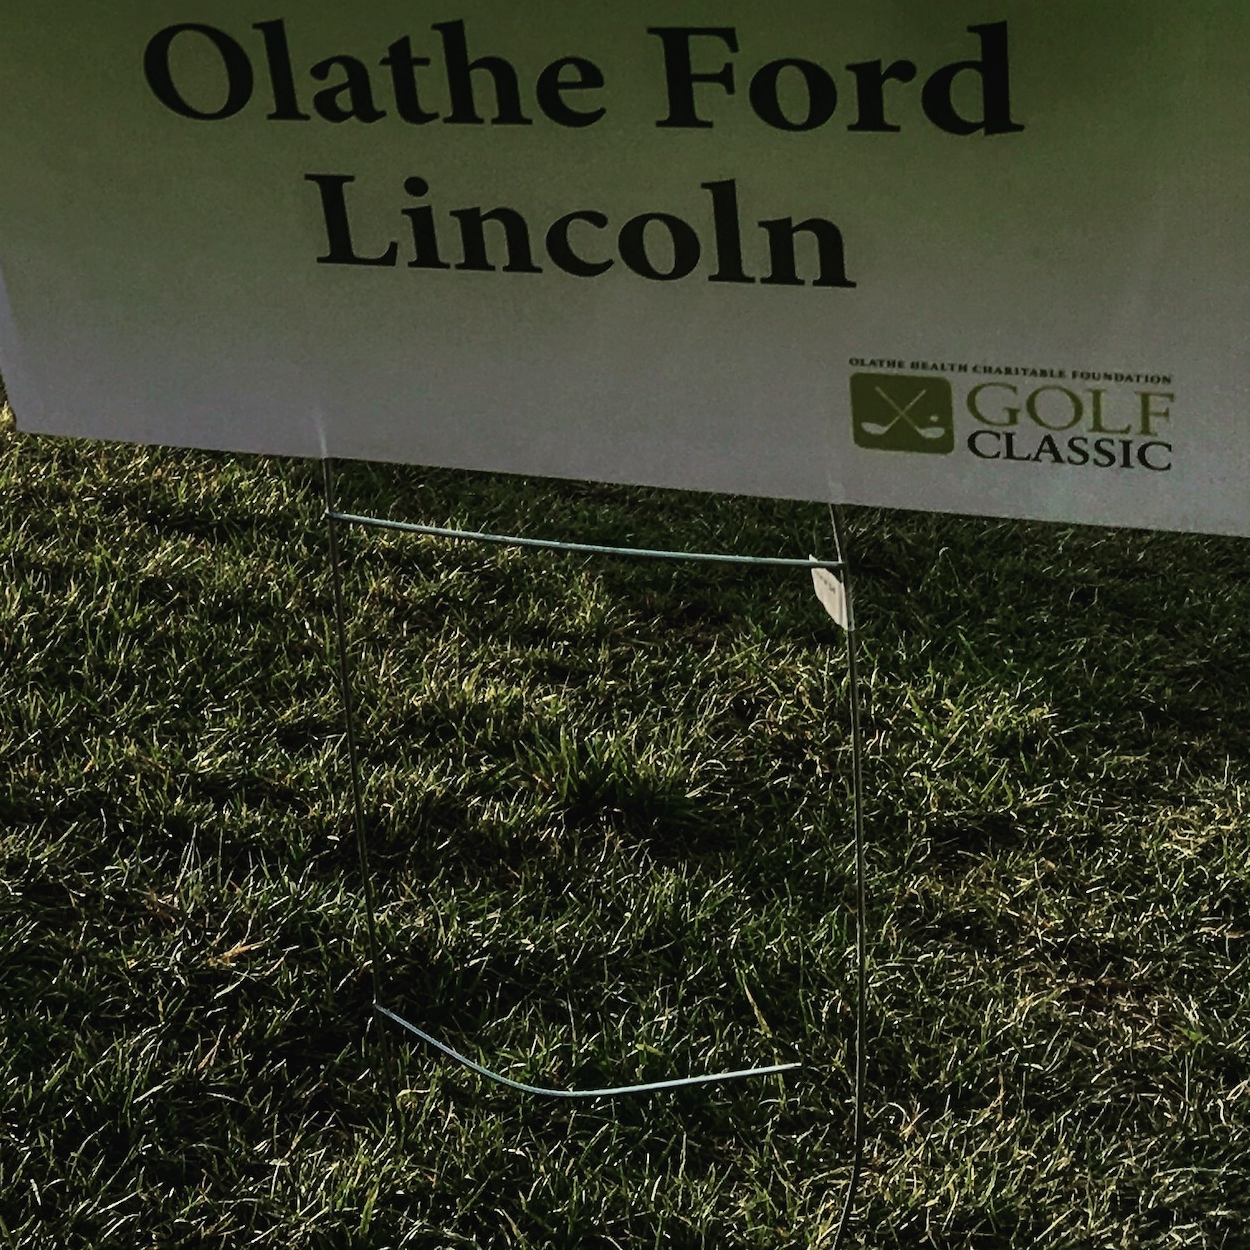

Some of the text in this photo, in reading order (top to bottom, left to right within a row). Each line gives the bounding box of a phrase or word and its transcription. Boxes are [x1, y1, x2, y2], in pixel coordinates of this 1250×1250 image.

[143, 18, 1025, 136] Olathe Ford
[303, 173, 857, 288] Lincoln
[849, 357, 1172, 384] OLATHE HEALTH CHARITABLE FOUNDATION
[966, 382, 1175, 436] GOLF
[967, 430, 1173, 471] CLASSIC
